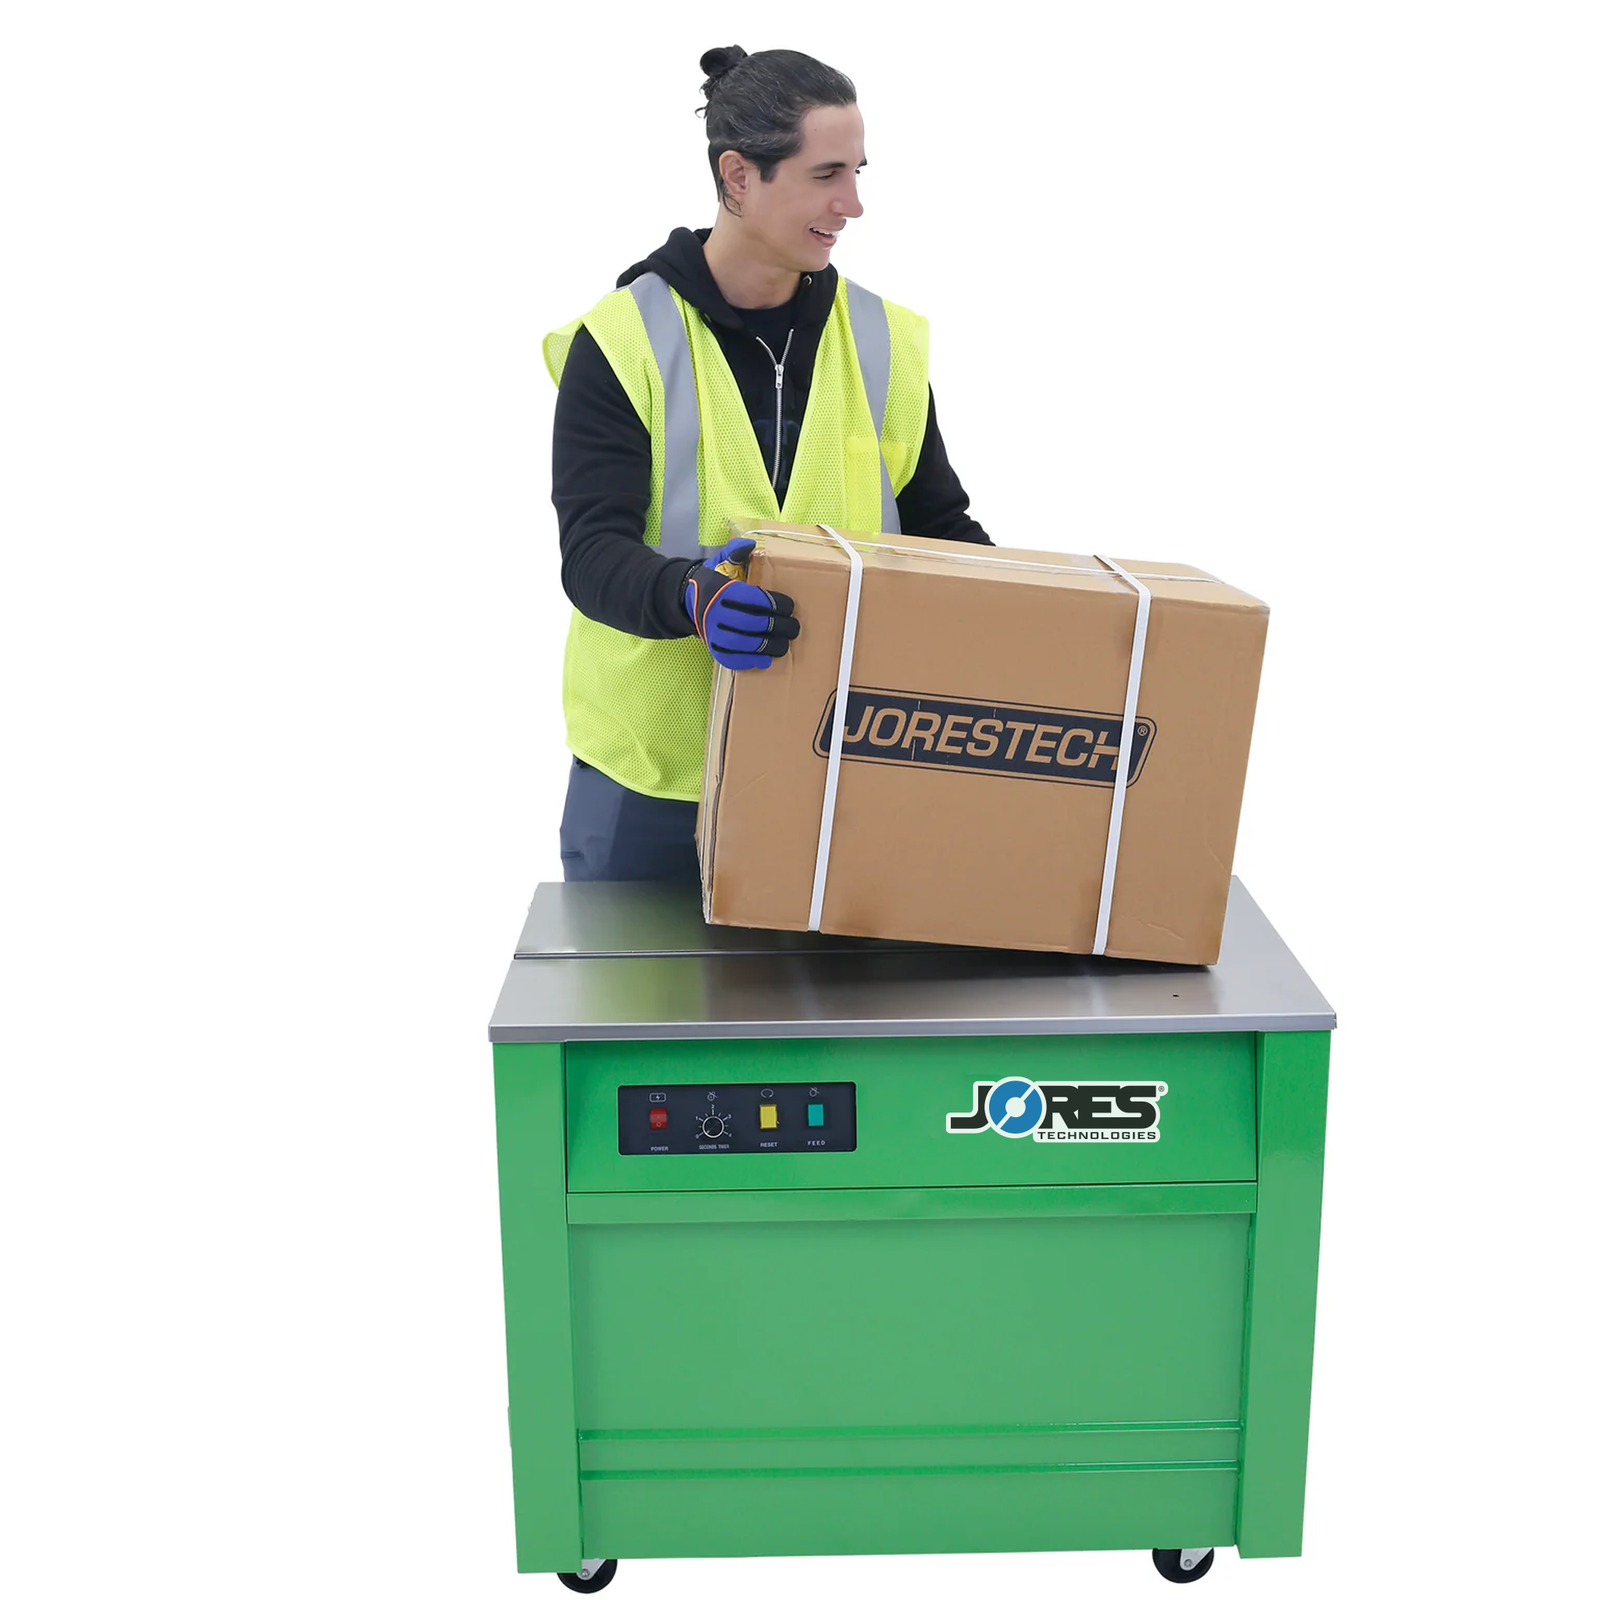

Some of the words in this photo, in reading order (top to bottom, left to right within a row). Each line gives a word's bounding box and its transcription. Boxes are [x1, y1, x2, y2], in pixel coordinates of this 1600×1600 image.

[843, 705, 1121, 771] JORESTECH
[951, 1080, 1157, 1134] JORES
[1037, 1131, 1157, 1140] TECHNOLOGIES
